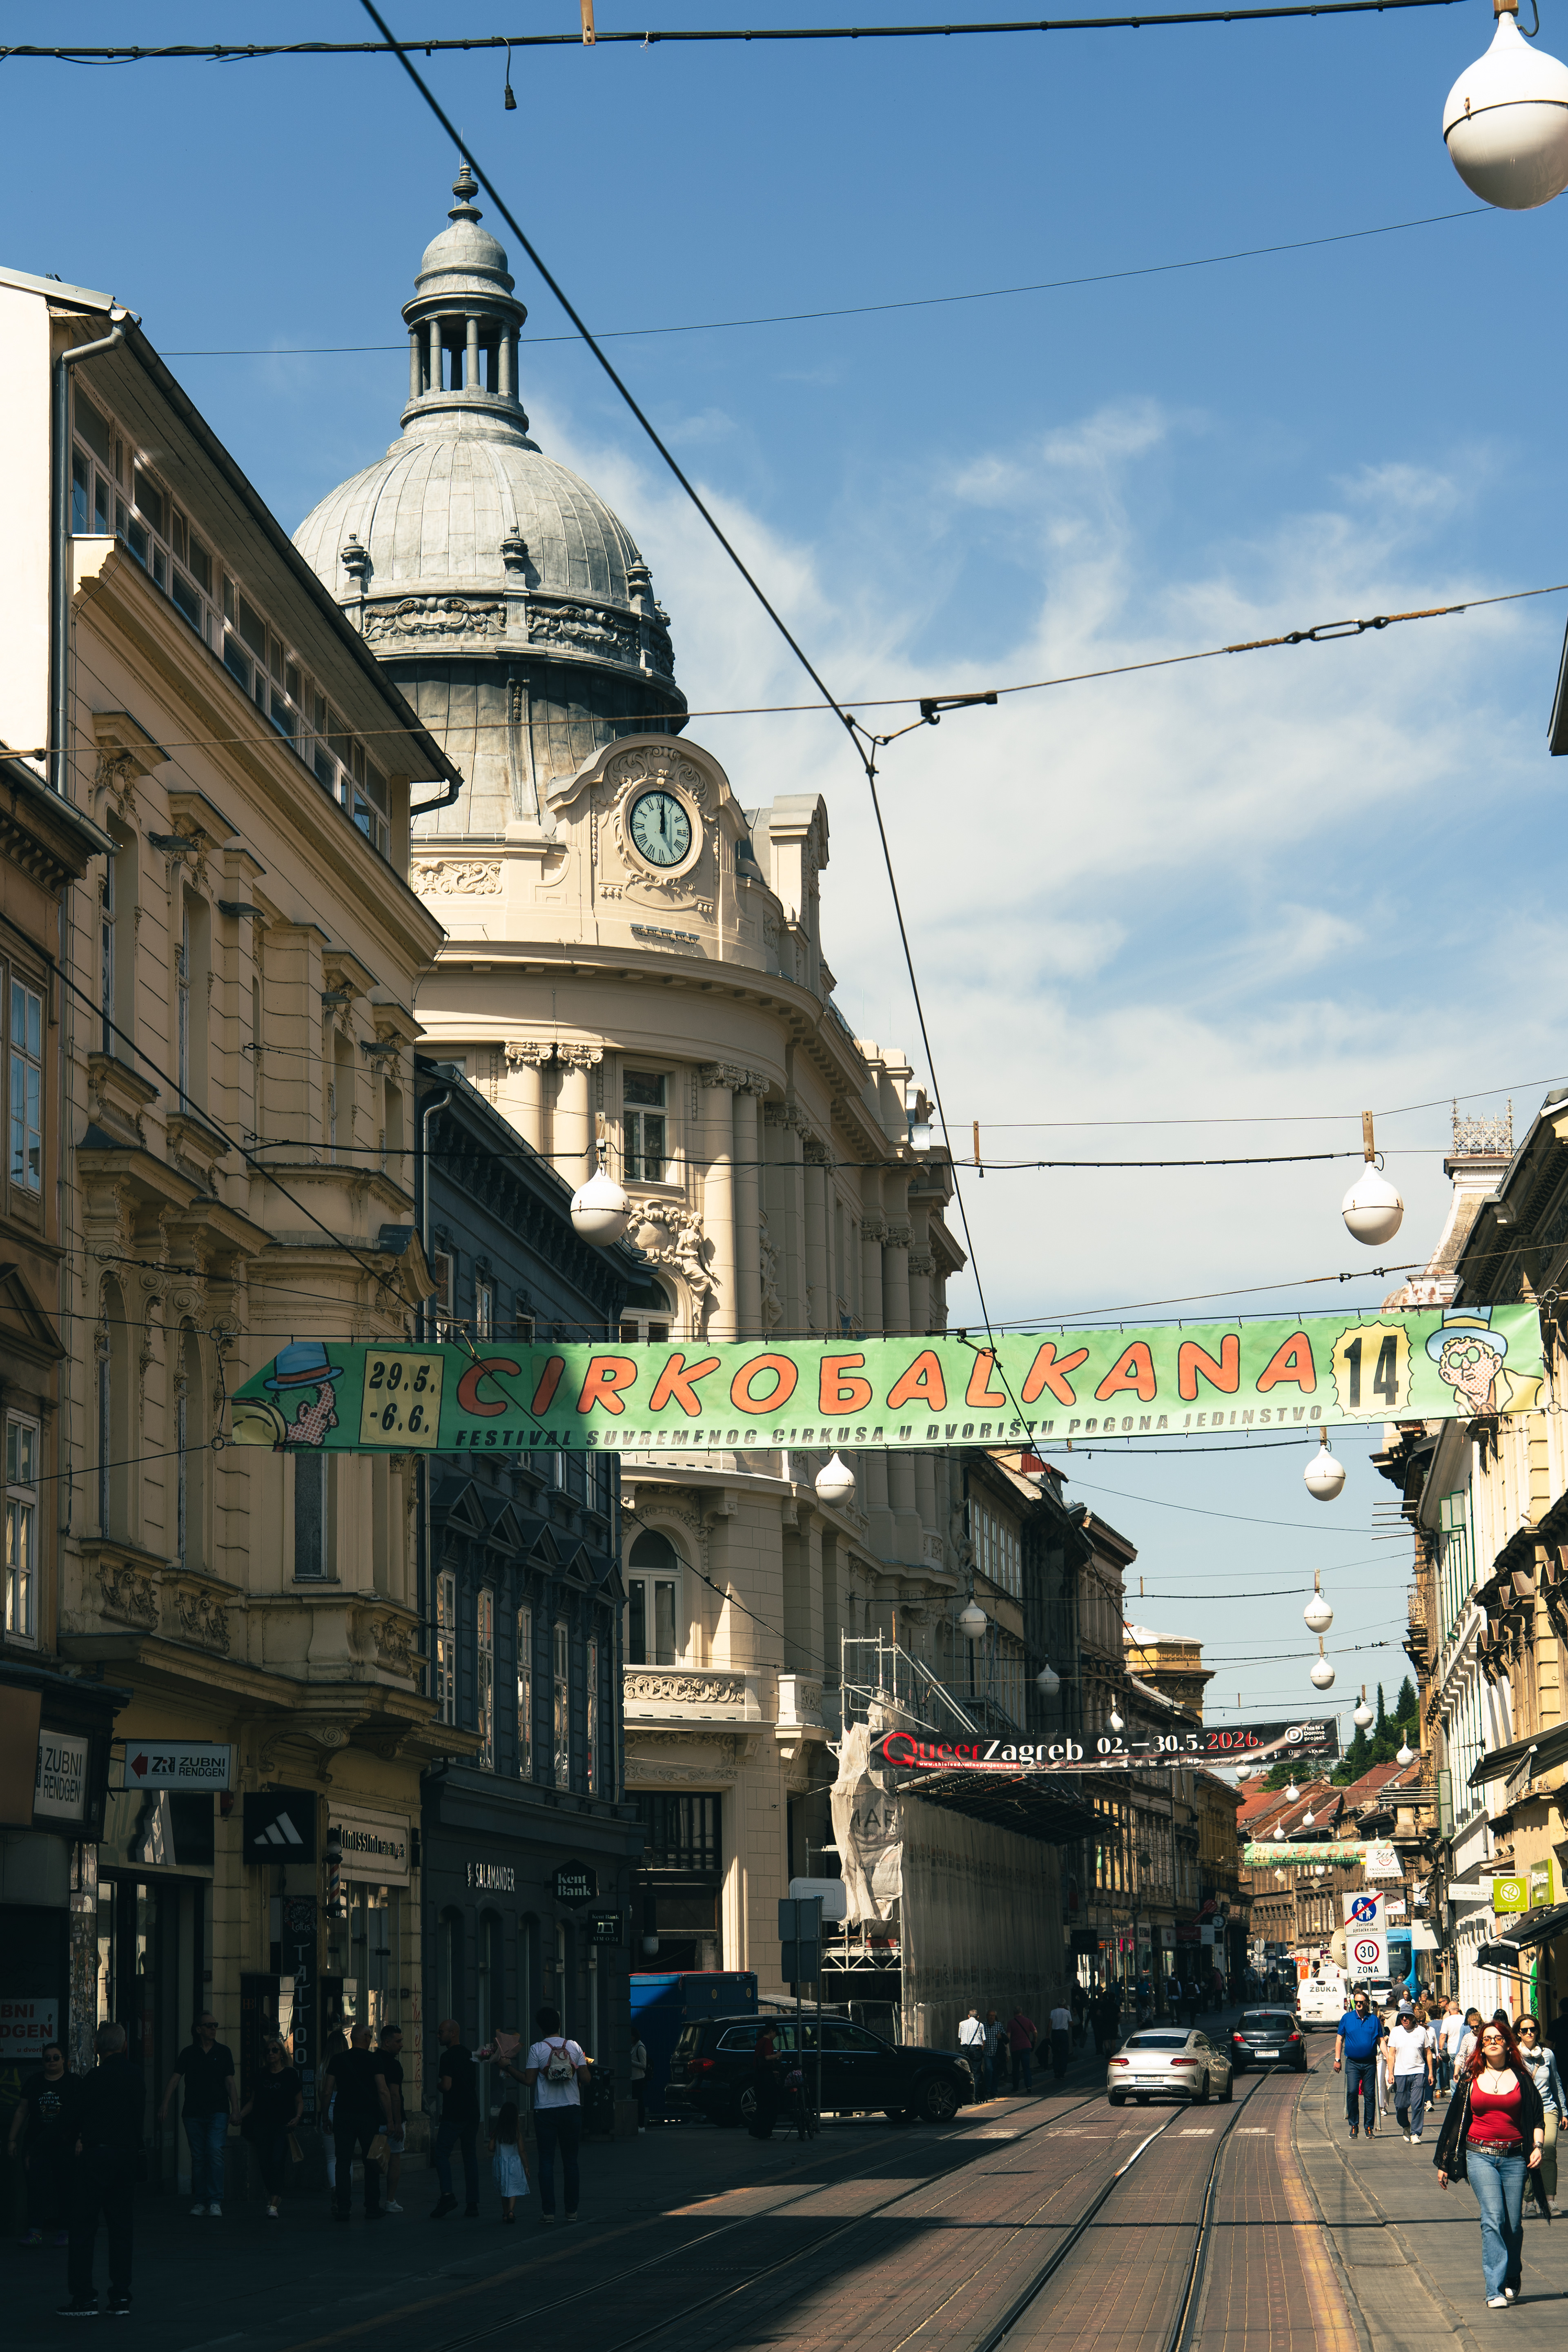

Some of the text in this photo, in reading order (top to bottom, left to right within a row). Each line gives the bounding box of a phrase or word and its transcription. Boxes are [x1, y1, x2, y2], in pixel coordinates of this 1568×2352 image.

[372, 1361, 435, 1392] 29.5.
[1343, 1334, 1399, 1408] 14
[370, 1405, 429, 1432] -6.6.
[455, 1405, 1322, 1446] FESTIVAL SUVREMENOG CIRKUSA U DVORIŠTU POGONA JEDINSTVO
[1207, 1731, 1264, 1750] 2026.
[45, 1748, 82, 1776] ZUBNI
[179, 1757, 225, 1767] ZUBNI
[179, 1767, 225, 1777] RENDGEN
[44, 1775, 80, 1803] RENDGEN
[476, 1863, 515, 1892] SALAMANDER
[558, 1873, 586, 1883] Kent
[558, 1885, 591, 1895] Bank
[292, 1921, 310, 1933] Lotus
[1360, 1946, 1374, 1958] 30
